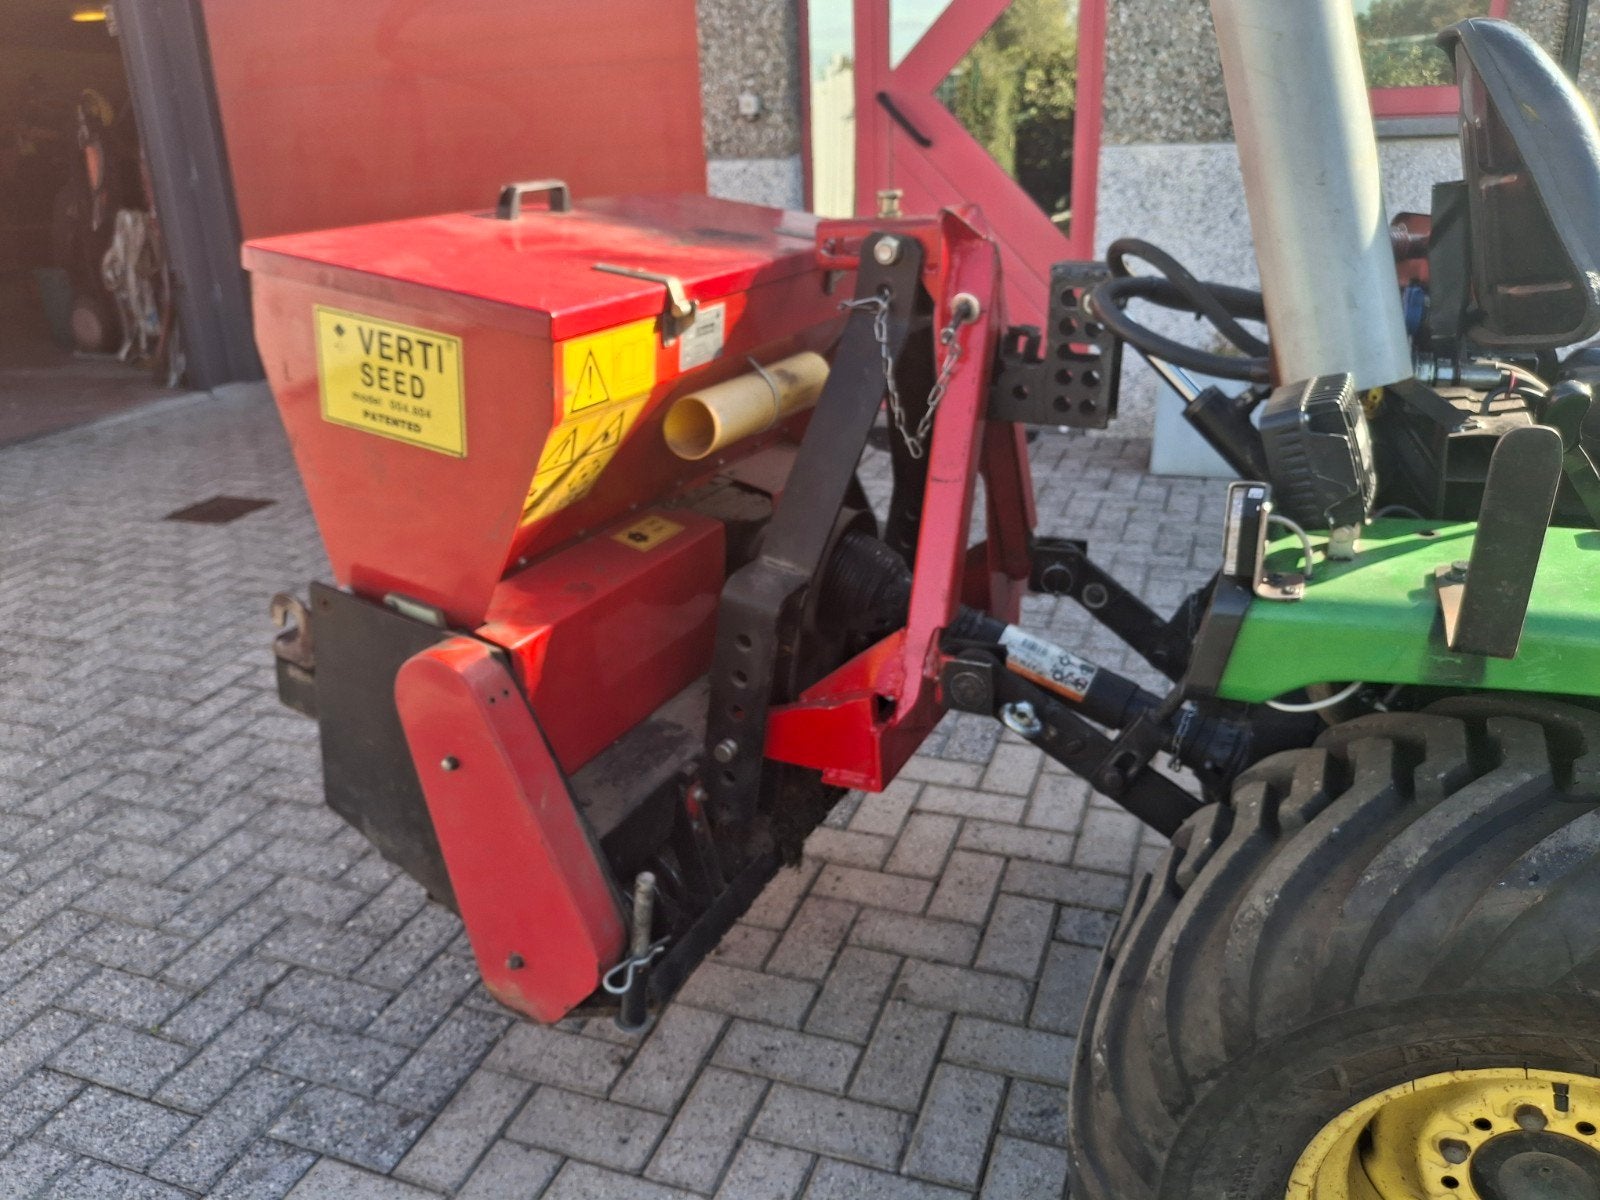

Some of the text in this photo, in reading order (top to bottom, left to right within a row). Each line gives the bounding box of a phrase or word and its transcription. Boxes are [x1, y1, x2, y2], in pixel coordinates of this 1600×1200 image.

[358, 325, 443, 374] VERTI
[361, 361, 425, 399] SEED
[363, 408, 422, 434] PATENTED
